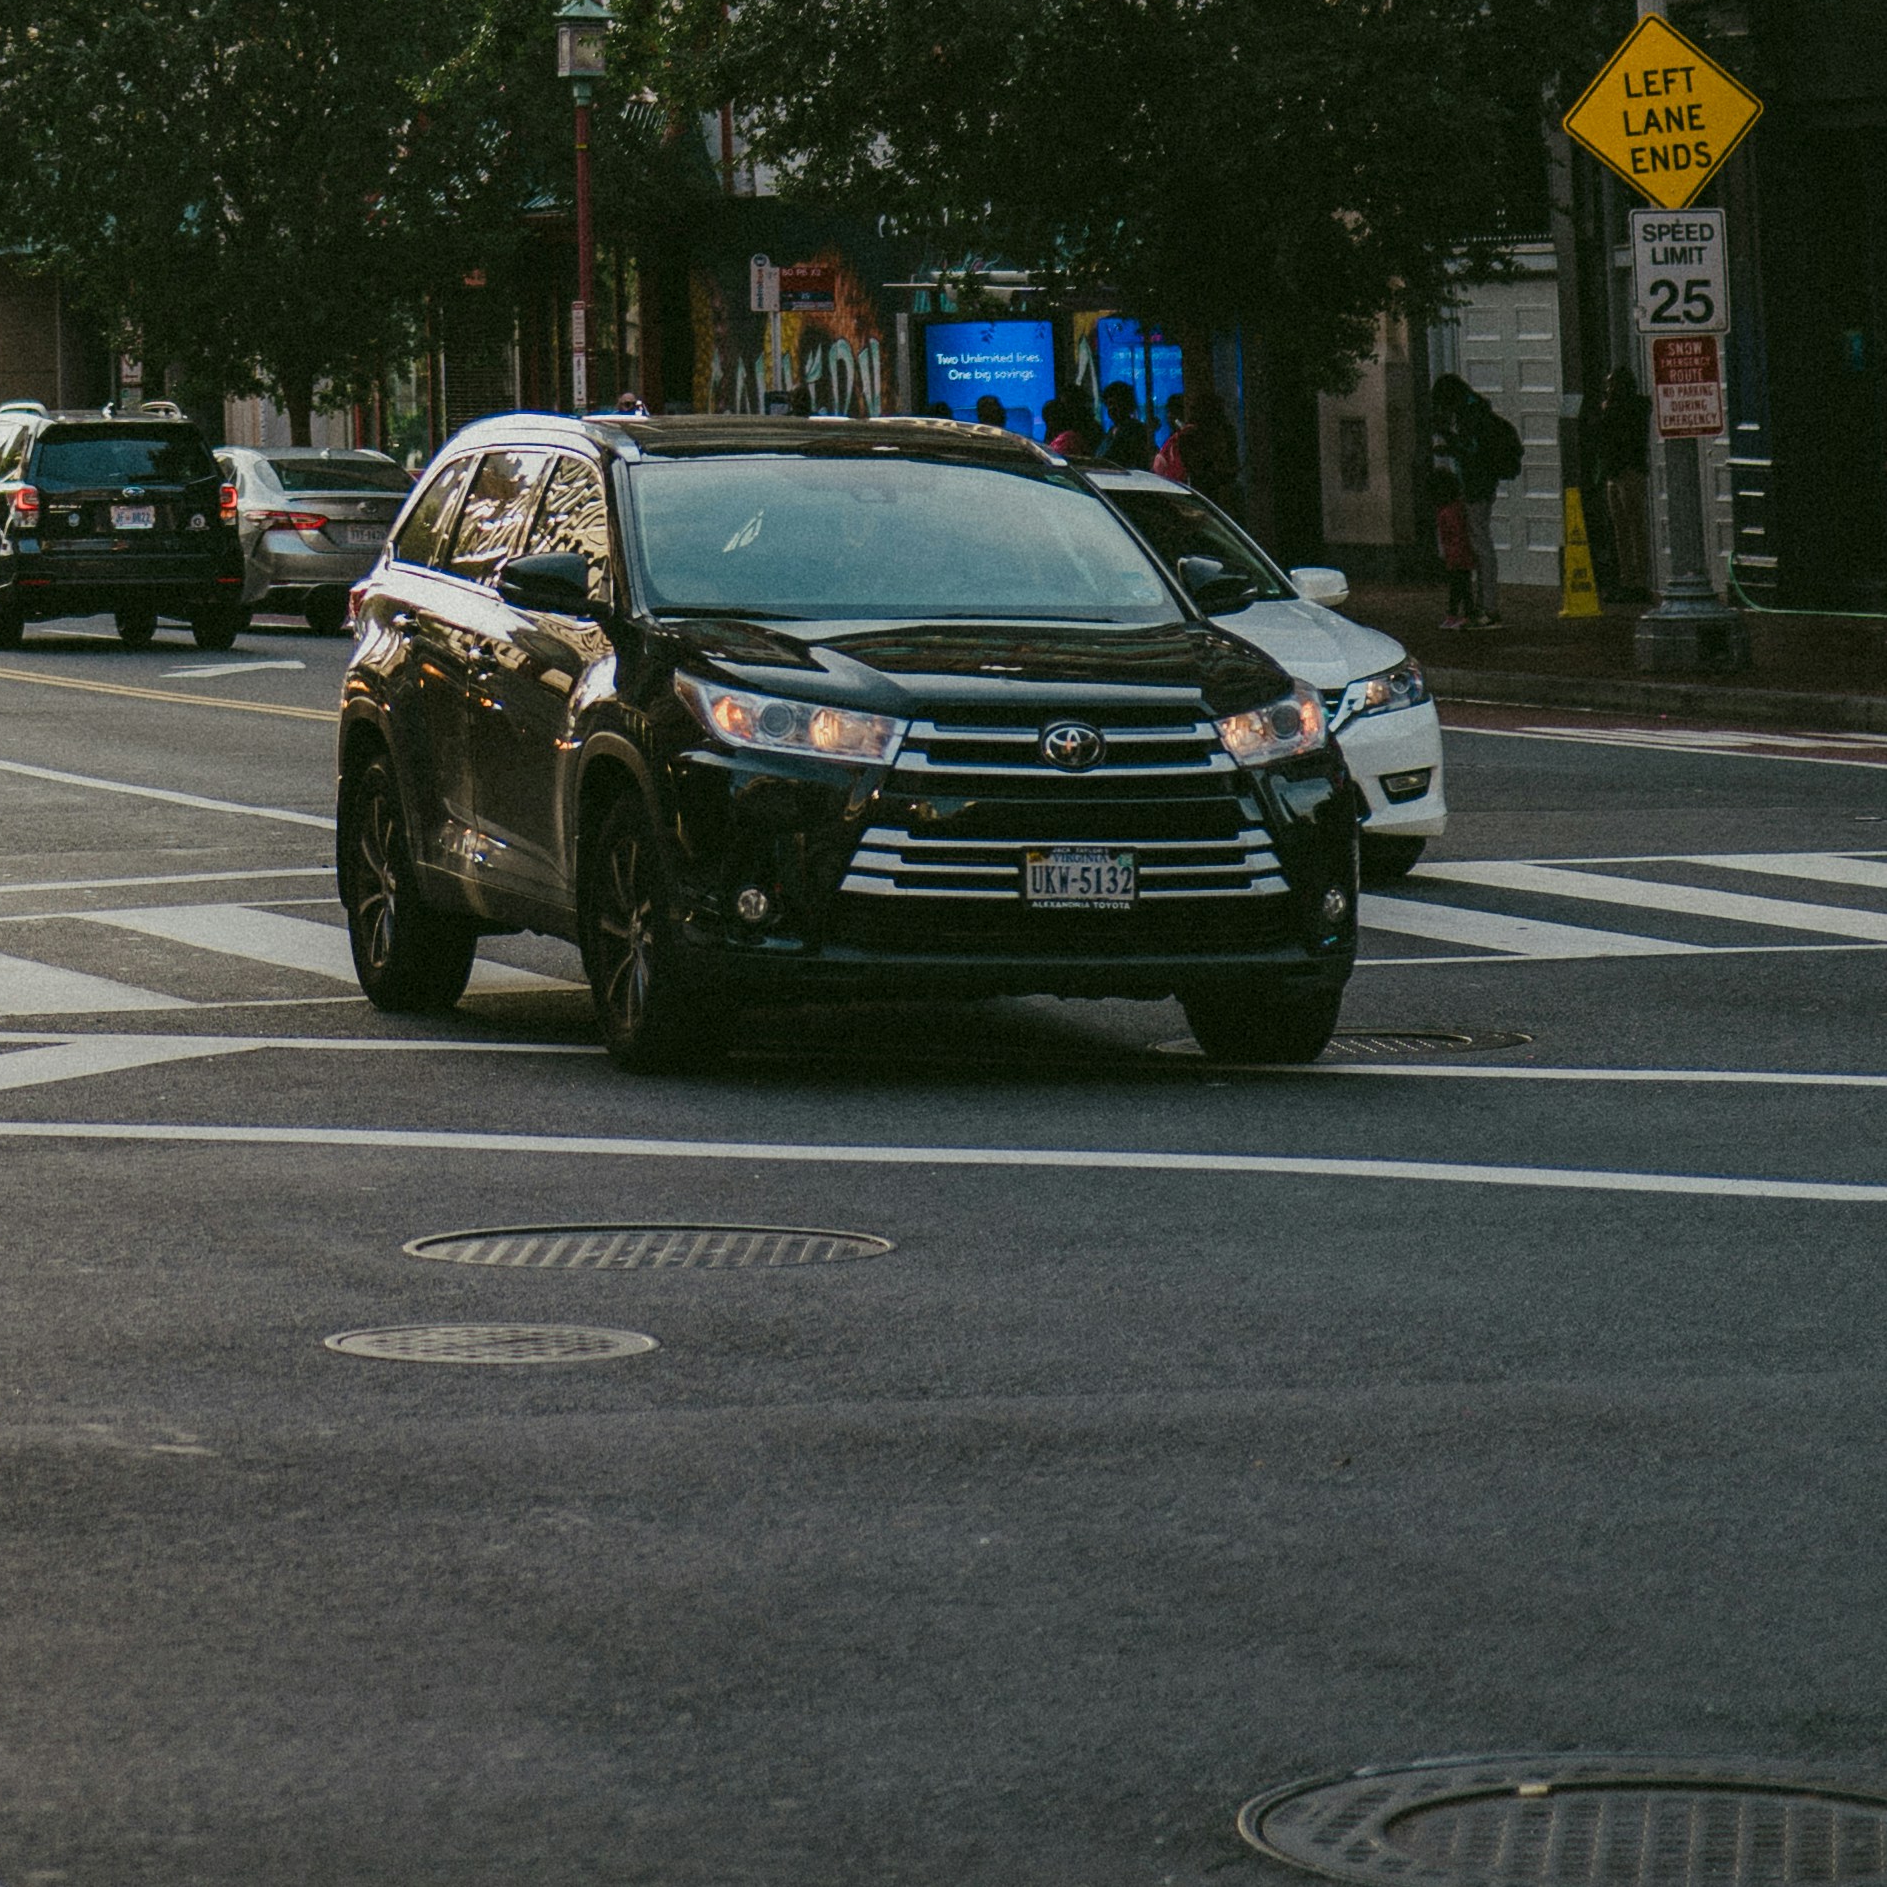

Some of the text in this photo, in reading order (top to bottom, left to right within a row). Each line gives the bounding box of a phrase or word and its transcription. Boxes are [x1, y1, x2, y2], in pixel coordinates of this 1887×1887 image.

[1624, 67, 1695, 98] LEFT
[1623, 104, 1705, 137] LANE
[1631, 141, 1712, 174] ENDS
[1642, 223, 1714, 242] SPEED
[1651, 246, 1707, 265] LIMIT
[1650, 279, 1714, 324] 25
[1667, 342, 1702, 354] SNOW
[936, 354, 958, 365] Two
[961, 352, 1014, 364] Unlimited
[1661, 357, 1711, 367] EMERGENCY
[948, 369, 972, 380] One
[974, 369, 991, 382] big
[1669, 369, 1703, 381] ROUTE
[1663, 384, 1713, 397] NO PARKING
[1671, 399, 1707, 412] DURING
[1664, 413, 1717, 427] EMERGENCY
[1053, 854, 1107, 864] VIRGINIA
[1032, 866, 1133, 895] UKW-5132
[1032, 900, 1130, 909] ALEXANDRIA TOYOTA
